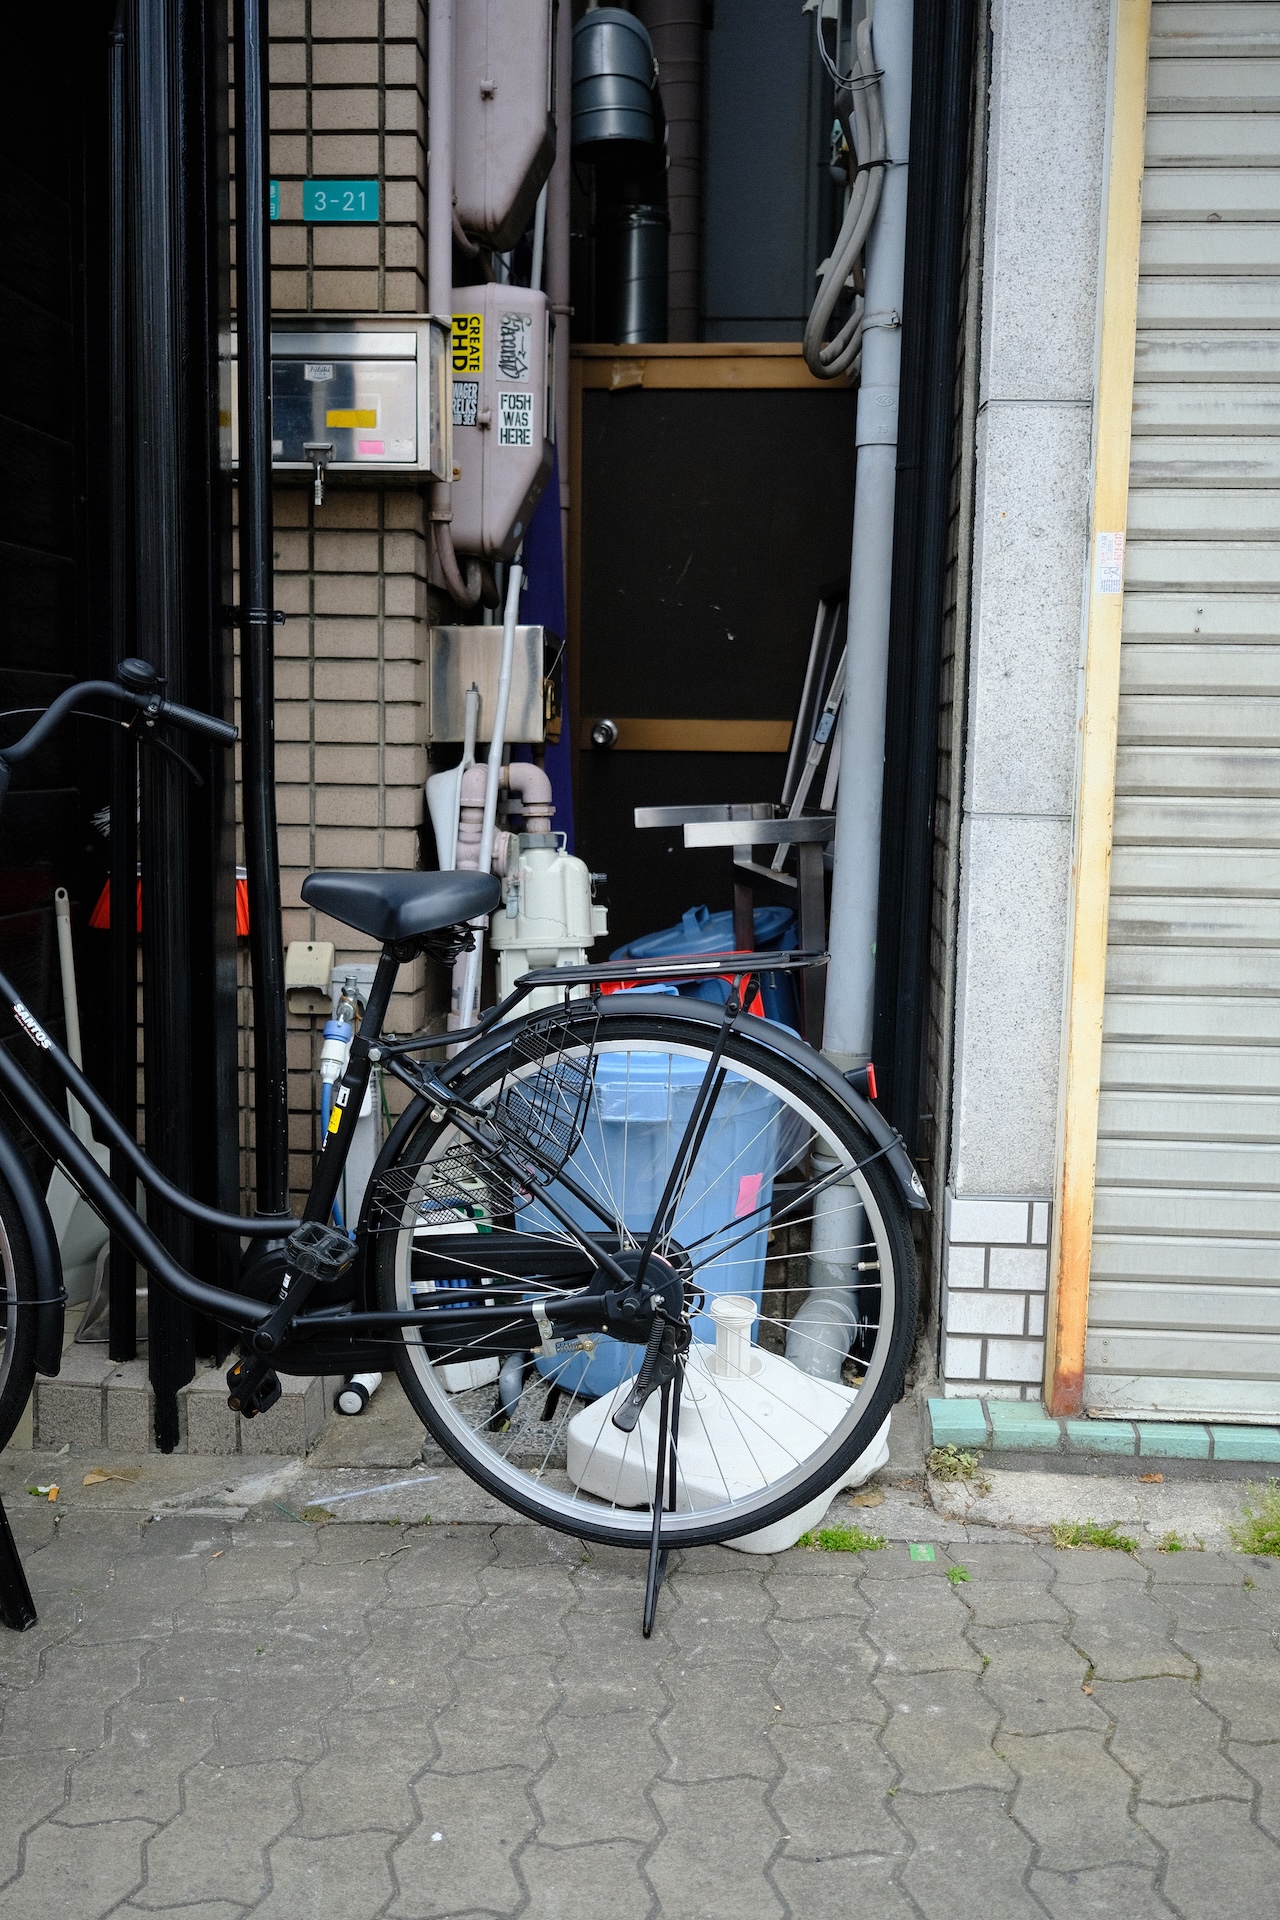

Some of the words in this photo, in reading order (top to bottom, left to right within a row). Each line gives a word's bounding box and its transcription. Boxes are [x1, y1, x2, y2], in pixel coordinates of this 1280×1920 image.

[314, 191, 365, 211] 3-21
[452, 318, 468, 371] PHD
[469, 316, 480, 371] CREATE
[503, 411, 529, 427] WAS
[500, 428, 531, 445] HERE
[14, 1003, 52, 1049] SANTOS
